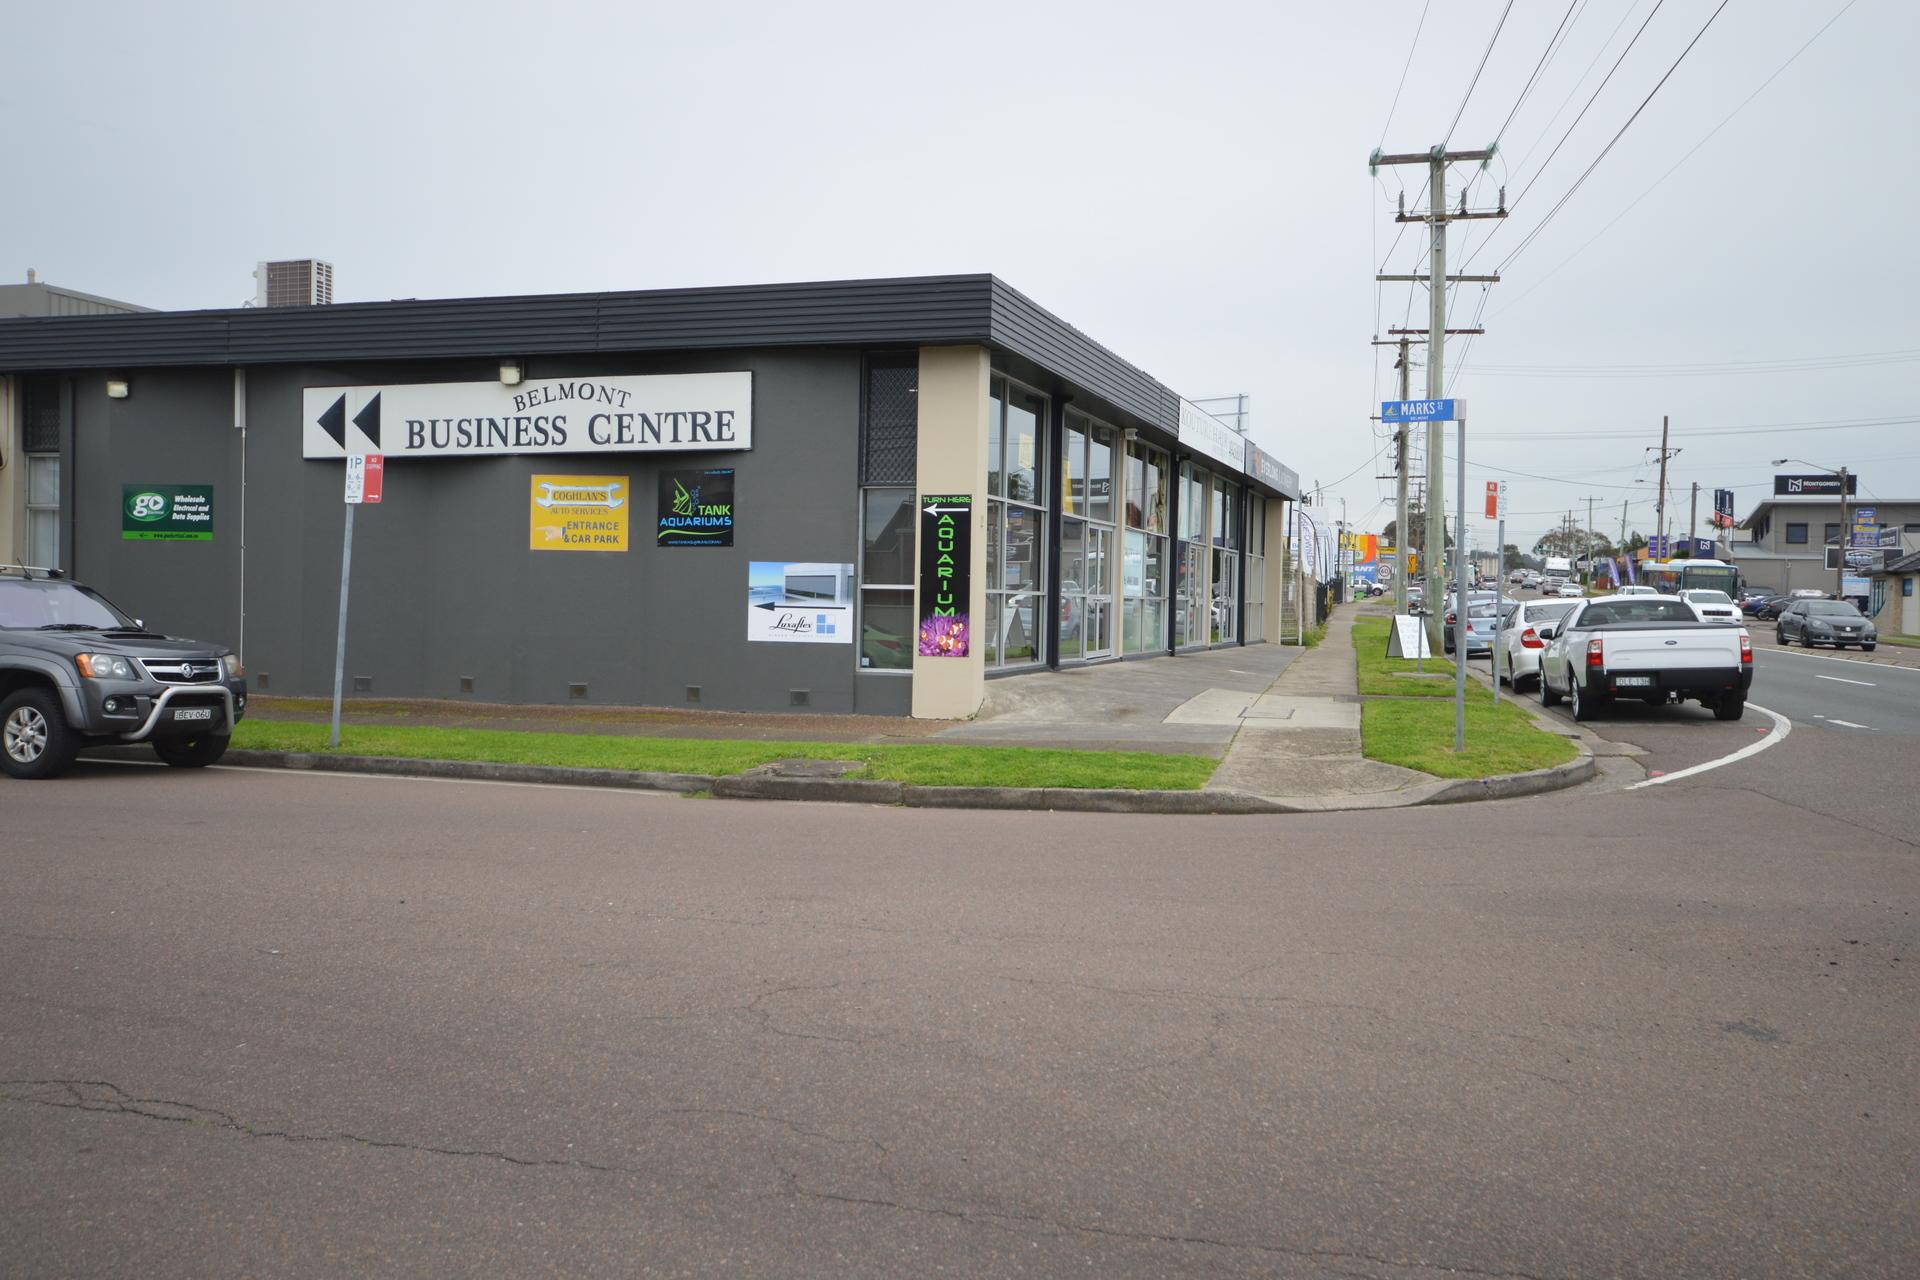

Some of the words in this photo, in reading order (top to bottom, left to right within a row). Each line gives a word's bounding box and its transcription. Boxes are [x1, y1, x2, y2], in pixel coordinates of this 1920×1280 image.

[513, 382, 632, 412] BELMONT
[1401, 402, 1436, 415] MARKS
[405, 415, 567, 449] BUSINESS
[588, 410, 735, 445] CENTRE
[174, 495, 206, 503] Wholesale
[553, 491, 607, 500] COGHLAN'S
[172, 504, 198, 512] Electrical
[698, 505, 731, 516] TANK
[172, 512, 186, 520] Data
[186, 513, 210, 521] Supplies
[567, 521, 619, 531] ENTRANCE
[660, 517, 732, 527] AQUARIUMS
[571, 535, 591, 544] CAR
[594, 535, 619, 544] PARK
[934, 514, 955, 617] AQUARIUM
[768, 613, 812, 633] Luxaflex
